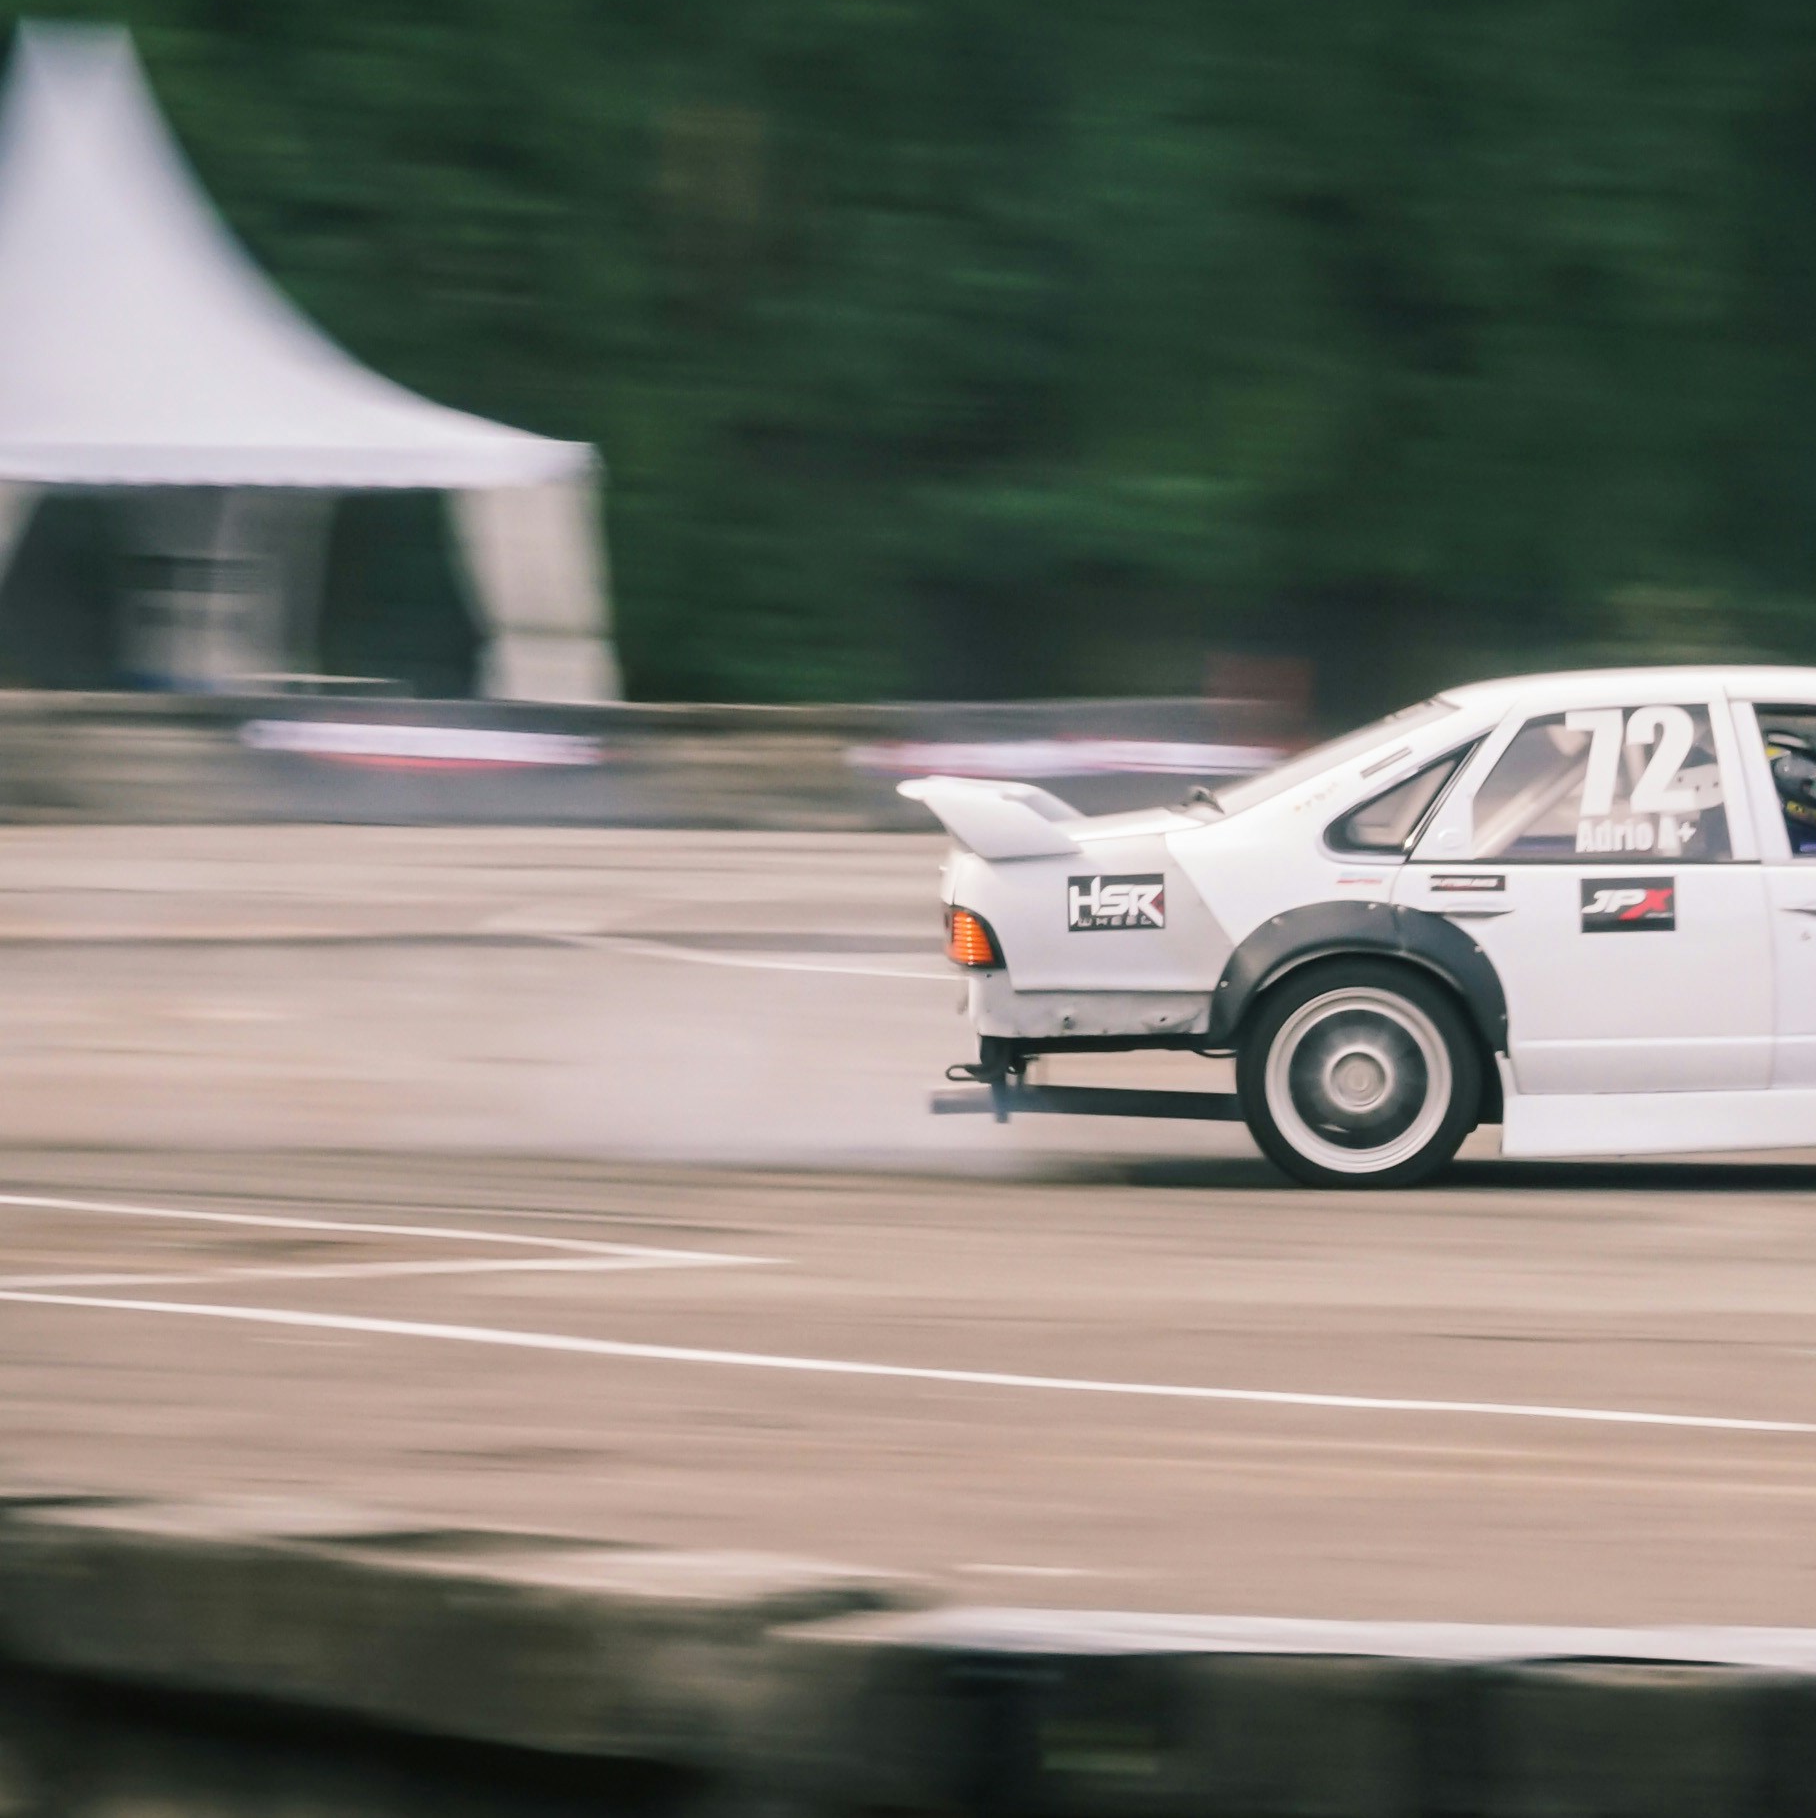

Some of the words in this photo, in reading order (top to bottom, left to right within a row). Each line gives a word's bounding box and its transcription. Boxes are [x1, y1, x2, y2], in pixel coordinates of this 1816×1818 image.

[1565, 704, 1695, 814] 72
[1575, 817, 1654, 853] Adrio
[1069, 876, 1164, 927] HSR
[1581, 888, 1674, 921] JPX
